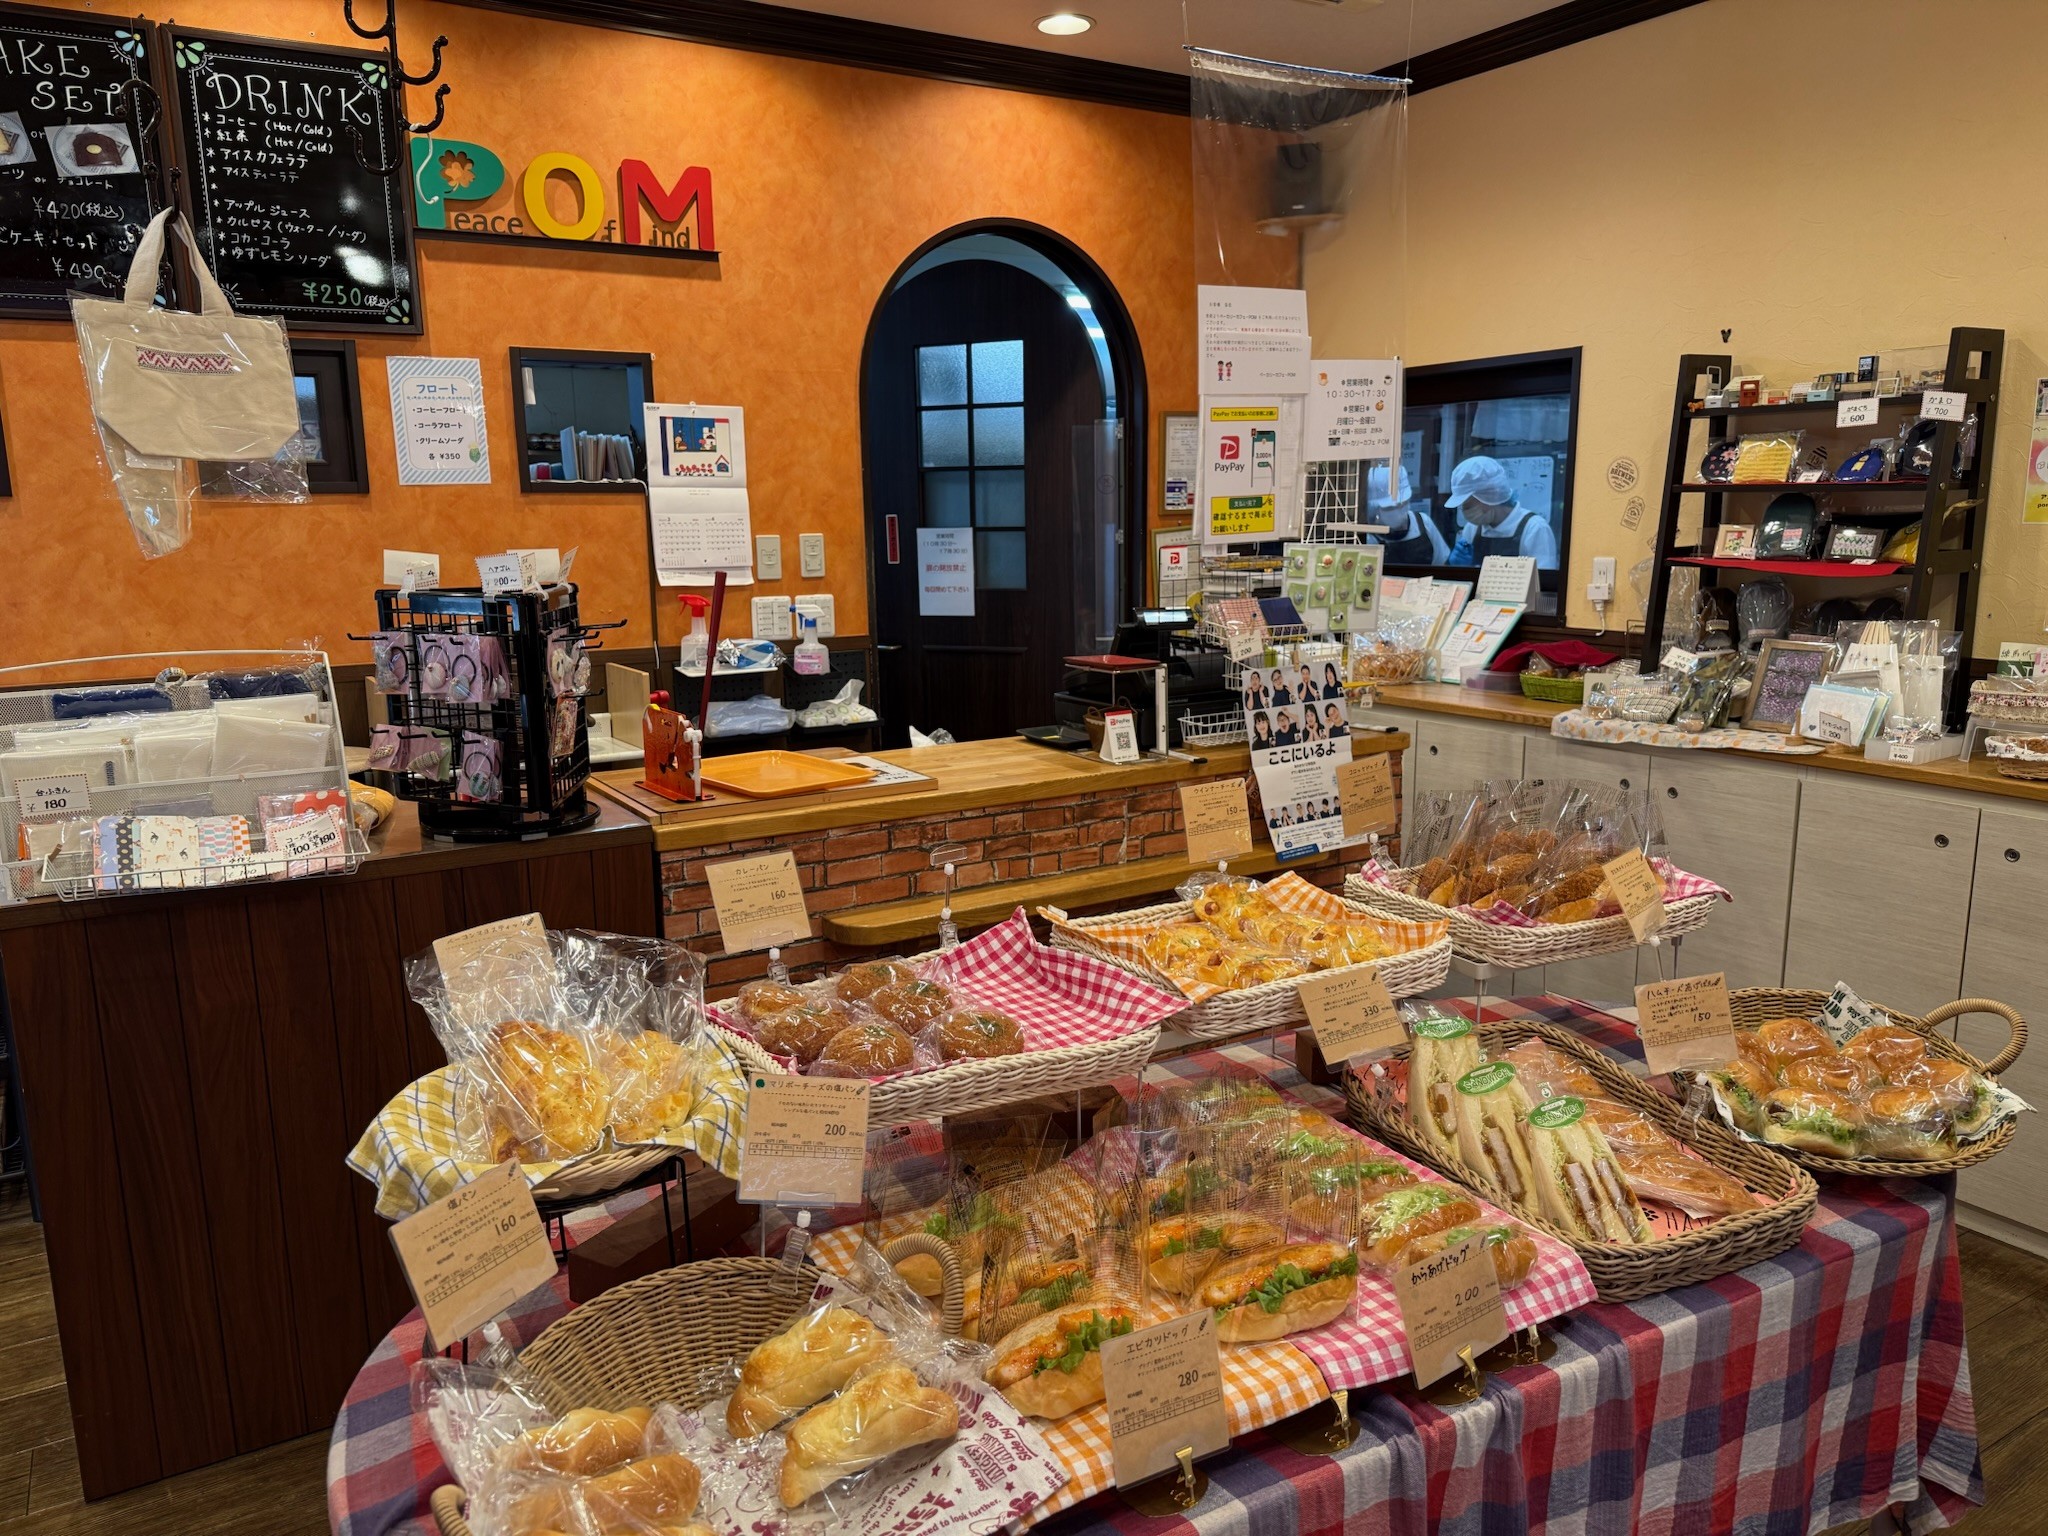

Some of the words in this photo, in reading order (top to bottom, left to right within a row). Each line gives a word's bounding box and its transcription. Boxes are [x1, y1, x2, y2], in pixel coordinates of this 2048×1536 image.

[31, 80, 121, 118] SET
[206, 73, 372, 124] DRINK
[216, 115, 258, 127] コーヒー
[216, 129, 249, 142] 紅茶
[220, 148, 308, 169] アイスカフェラテ
[222, 167, 300, 184] アイスティーラテ
[58, 177, 114, 190] チョコレート
[231, 232, 291, 250] コカ・コーラ
[416, 384, 458, 395] フロート
[1346, 378, 1370, 387] 営業時間
[1348, 404, 1366, 414] 営業日
[1934, 407, 1949, 416] 700
[1849, 414, 1865, 422] 600
[440, 452, 461, 460] ¥350
[1214, 462, 1246, 474] PayPay
[1610, 468, 1636, 483] BREWERY
[1240, 646, 1252, 656] 200
[1828, 730, 1841, 740] 200
[1269, 741, 1337, 766] ここにいるよ
[44, 798, 67, 810] 180
[1226, 806, 1238, 816] 150
[286, 829, 318, 844] コースター
[735, 862, 770, 876] カレーパン
[770, 889, 786, 901] 160
[1324, 978, 1358, 994] カツサンド
[1361, 1004, 1379, 1018] 330
[1693, 1011, 1711, 1024] 150
[1421, 1022, 1469, 1037] SANDWICH
[769, 1080, 857, 1094] マリボーチーズの塩パン
[1464, 1067, 1512, 1092] SANDWICH
[1534, 1104, 1582, 1127] SANDWICH
[825, 1123, 847, 1137] 200
[447, 1188, 477, 1211] 塩パン
[494, 1214, 518, 1237] 160
[1411, 1243, 1470, 1286] からあげドッグ
[1455, 1286, 1479, 1308] 200
[1126, 1323, 1189, 1355] エビカツドッグ
[1177, 1368, 1199, 1388] 280
[981, 1411, 1003, 1429] Side
[979, 1433, 1016, 1465] MINNIE
[1011, 1440, 1033, 1462] Side
[964, 1444, 1008, 1485] MICKEY
[897, 1477, 918, 1499] How
[879, 1497, 898, 1519] you
[950, 1511, 969, 1524] look
[969, 1499, 1002, 1518] further.
